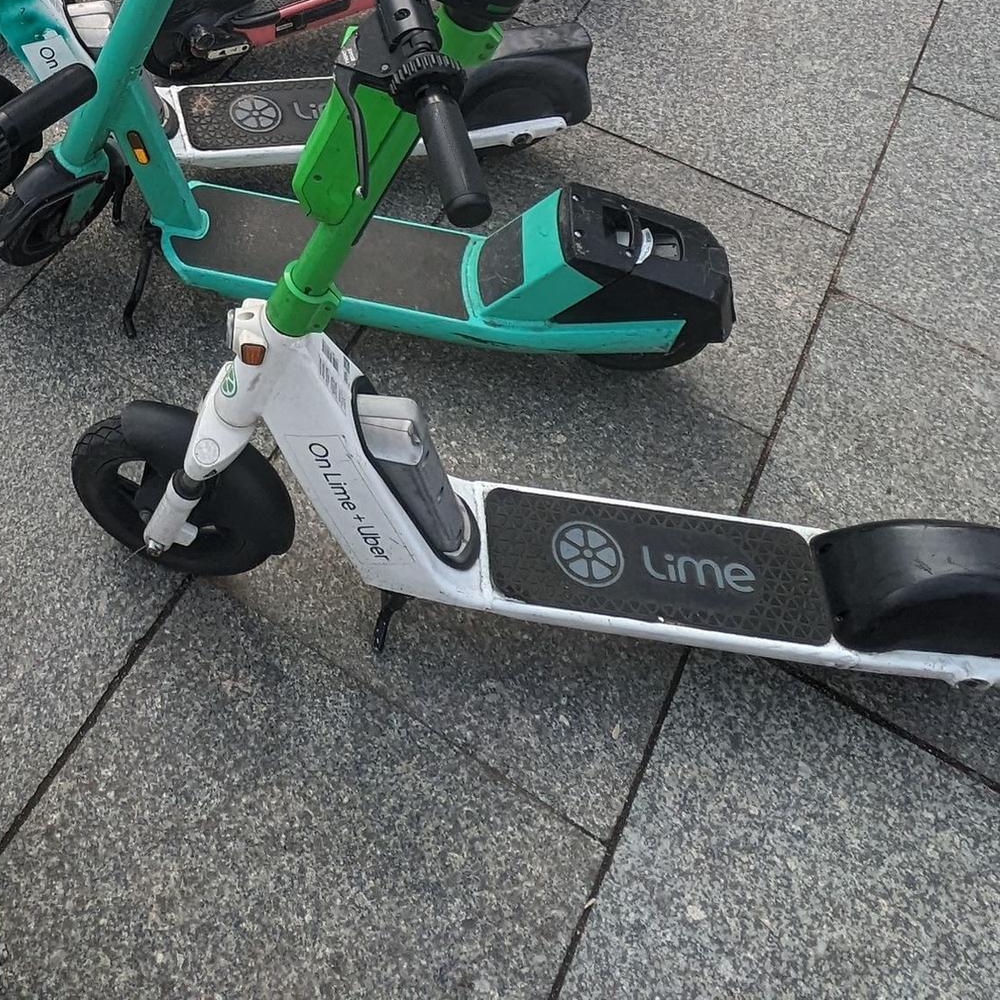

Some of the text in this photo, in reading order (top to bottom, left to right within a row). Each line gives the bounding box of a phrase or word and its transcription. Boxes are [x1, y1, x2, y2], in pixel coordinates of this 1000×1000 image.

[40, 47, 58, 69] On
[293, 102, 327, 119] Li
[308, 442, 390, 562] On Lime + Uber
[642, 545, 756, 593] Lime
